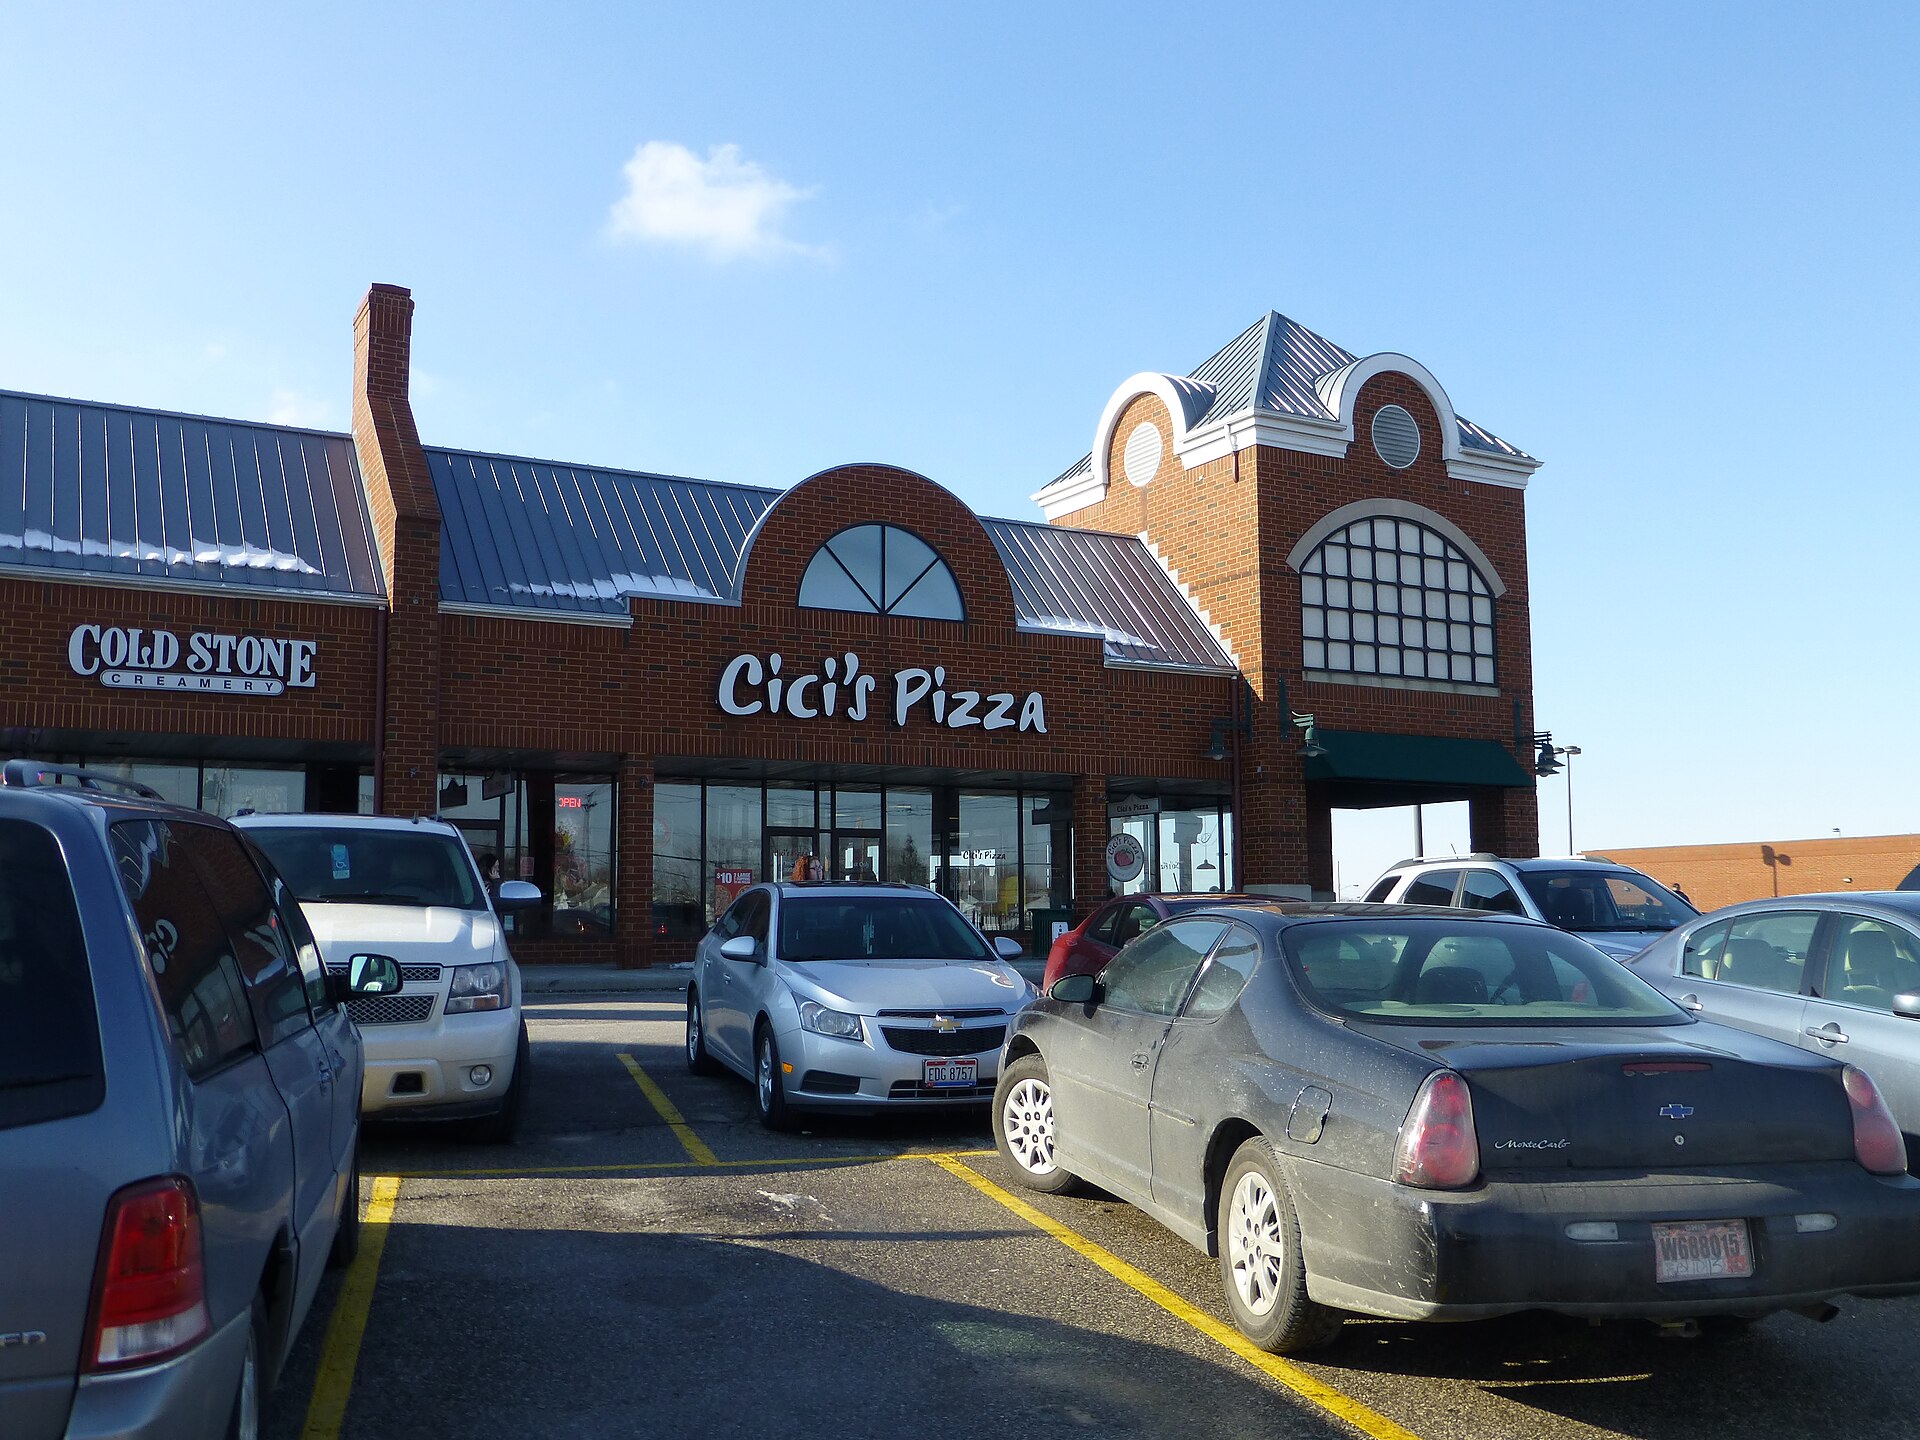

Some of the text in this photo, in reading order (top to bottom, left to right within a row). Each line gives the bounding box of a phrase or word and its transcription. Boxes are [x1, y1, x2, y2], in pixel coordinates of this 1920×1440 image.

[68, 624, 317, 687] COLD STONE
[111, 673, 275, 692] CREAMERY
[718, 652, 1047, 733] Cici's Pizza
[558, 797, 581, 808] OPEN
[716, 872, 733, 884] $10
[928, 1066, 973, 1081] EDG 8757
